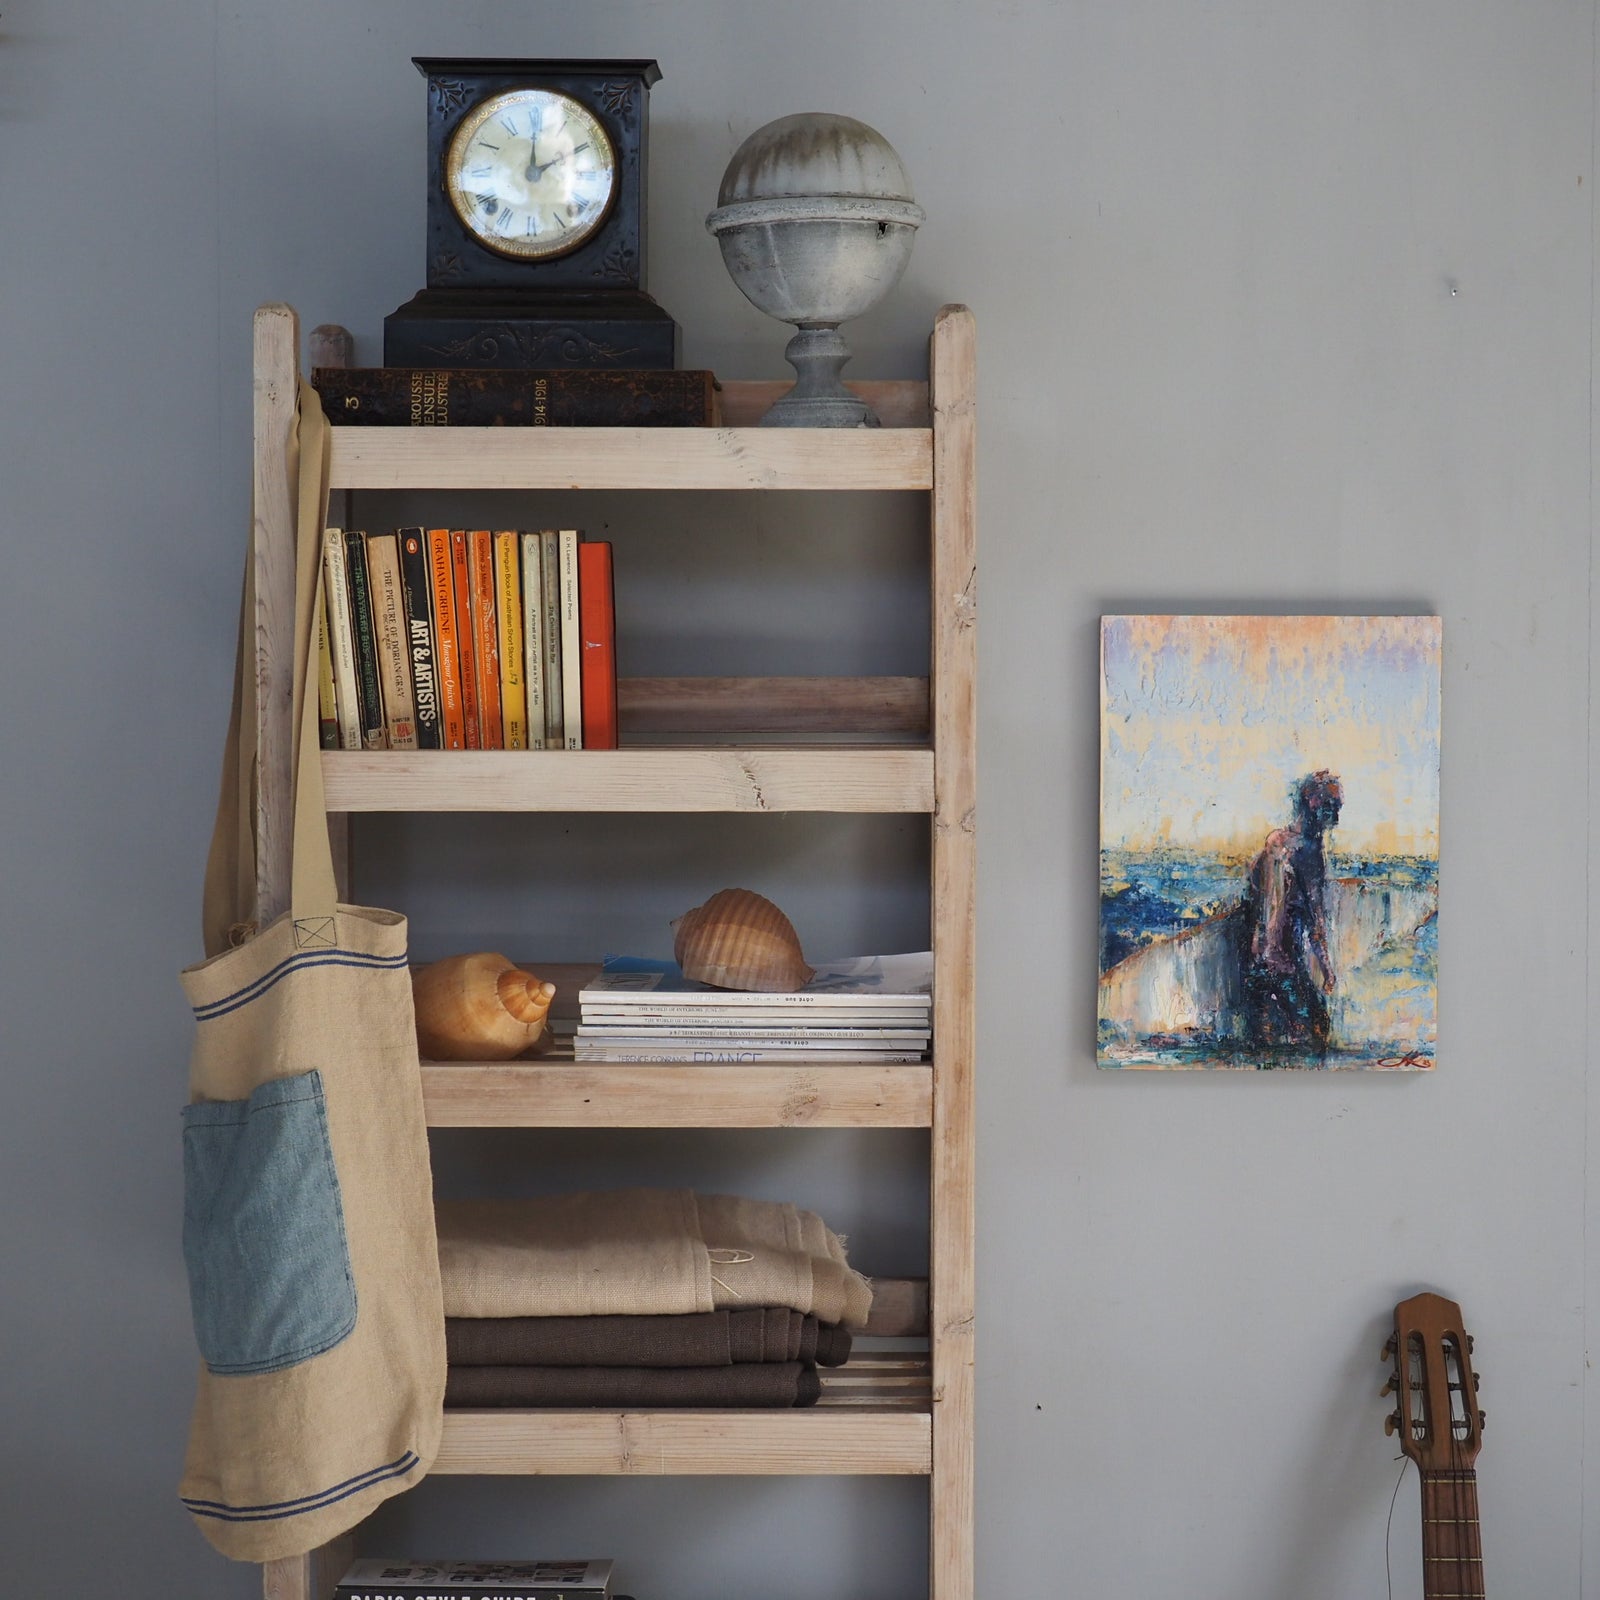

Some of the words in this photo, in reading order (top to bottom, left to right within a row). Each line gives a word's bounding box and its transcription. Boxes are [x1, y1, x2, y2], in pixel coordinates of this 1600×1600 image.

[345, 396, 359, 409] 3
[478, 538, 486, 562] Daphne
[434, 538, 446, 587] GRAHAM
[355, 568, 363, 584] THE
[384, 569, 392, 587] THE
[356, 587, 367, 632] WAYWARD
[386, 590, 397, 623] PICTURE
[439, 590, 450, 634] GREENE
[391, 627, 397, 637] OF
[410, 620, 429, 646] ART
[484, 633, 491, 642] on
[361, 635, 370, 653] BUS
[413, 647, 430, 662] &
[484, 643, 492, 653] the
[391, 640, 402, 672] DORIAN
[442, 639, 452, 679] Monsignor
[485, 654, 493, 675] Strand
[507, 646, 515, 668] Stories
[395, 676, 404, 697] GRAY
[444, 679, 454, 710] Quixote
[694, 1052, 763, 1063] FRANCE
